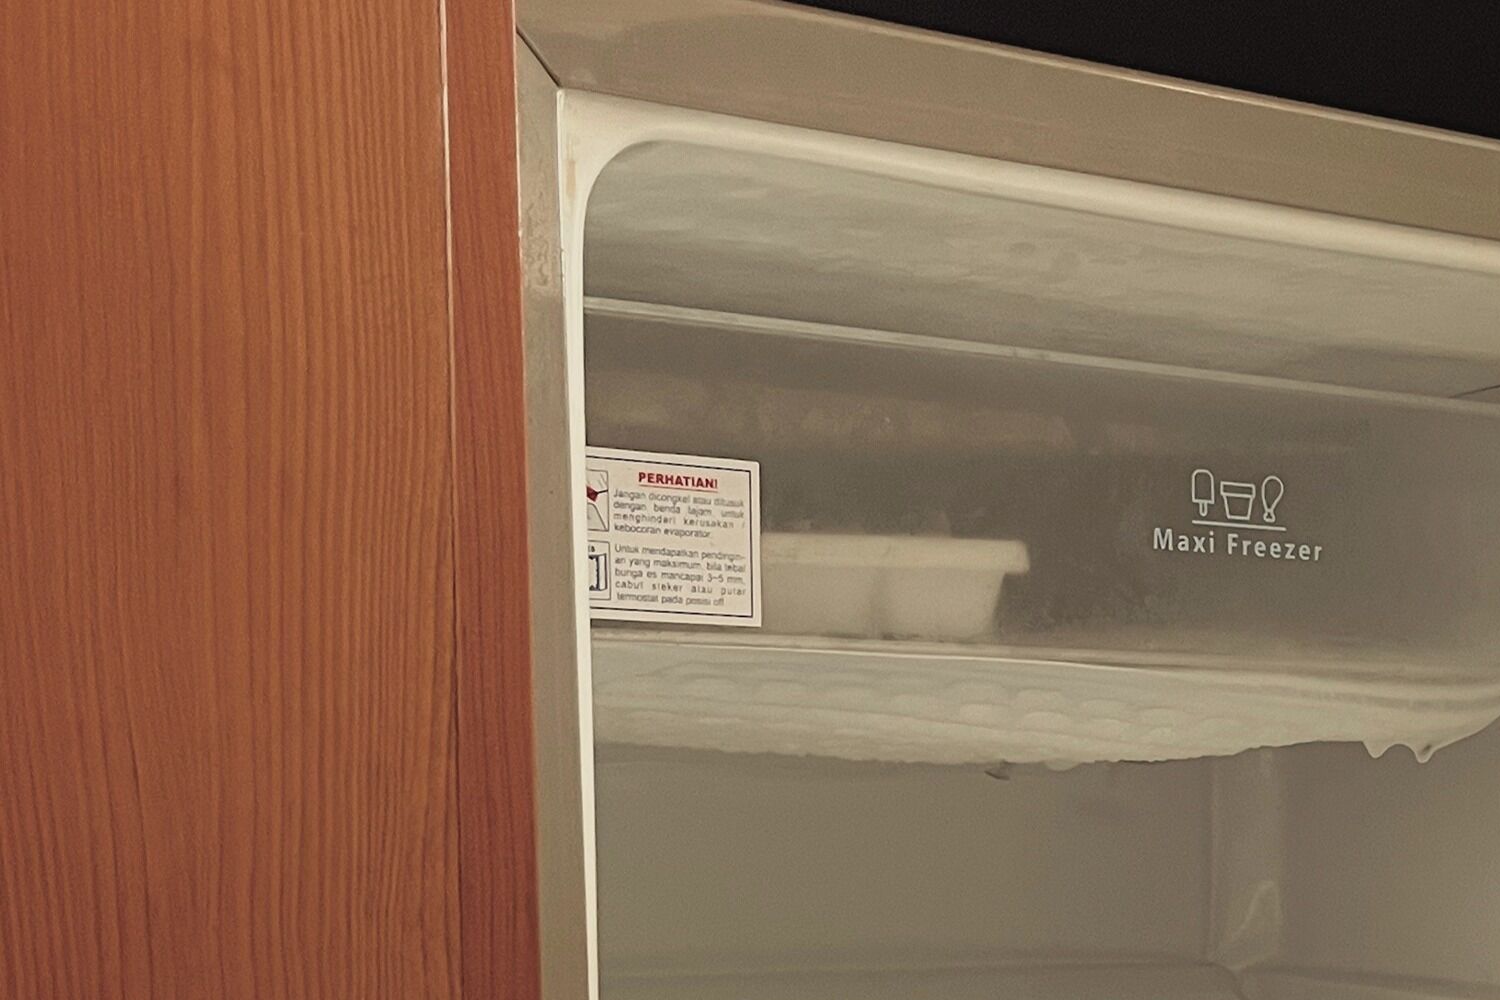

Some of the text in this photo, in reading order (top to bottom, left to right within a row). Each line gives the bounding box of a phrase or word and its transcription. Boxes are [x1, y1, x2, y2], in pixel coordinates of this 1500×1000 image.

[638, 472, 718, 489] PERHATIAN!
[613, 488, 646, 500] Jangan
[613, 501, 646, 512] dengan
[654, 503, 680, 514] benda
[614, 523, 662, 534] kebocoran
[683, 518, 734, 528] kerusakan
[614, 544, 638, 554] Untuk
[1152, 527, 1323, 561] Maxi Freezer
[629, 558, 650, 568] yang
[614, 568, 643, 580] bunga
[615, 580, 644, 590] cabut
[661, 595, 683, 604] pada
